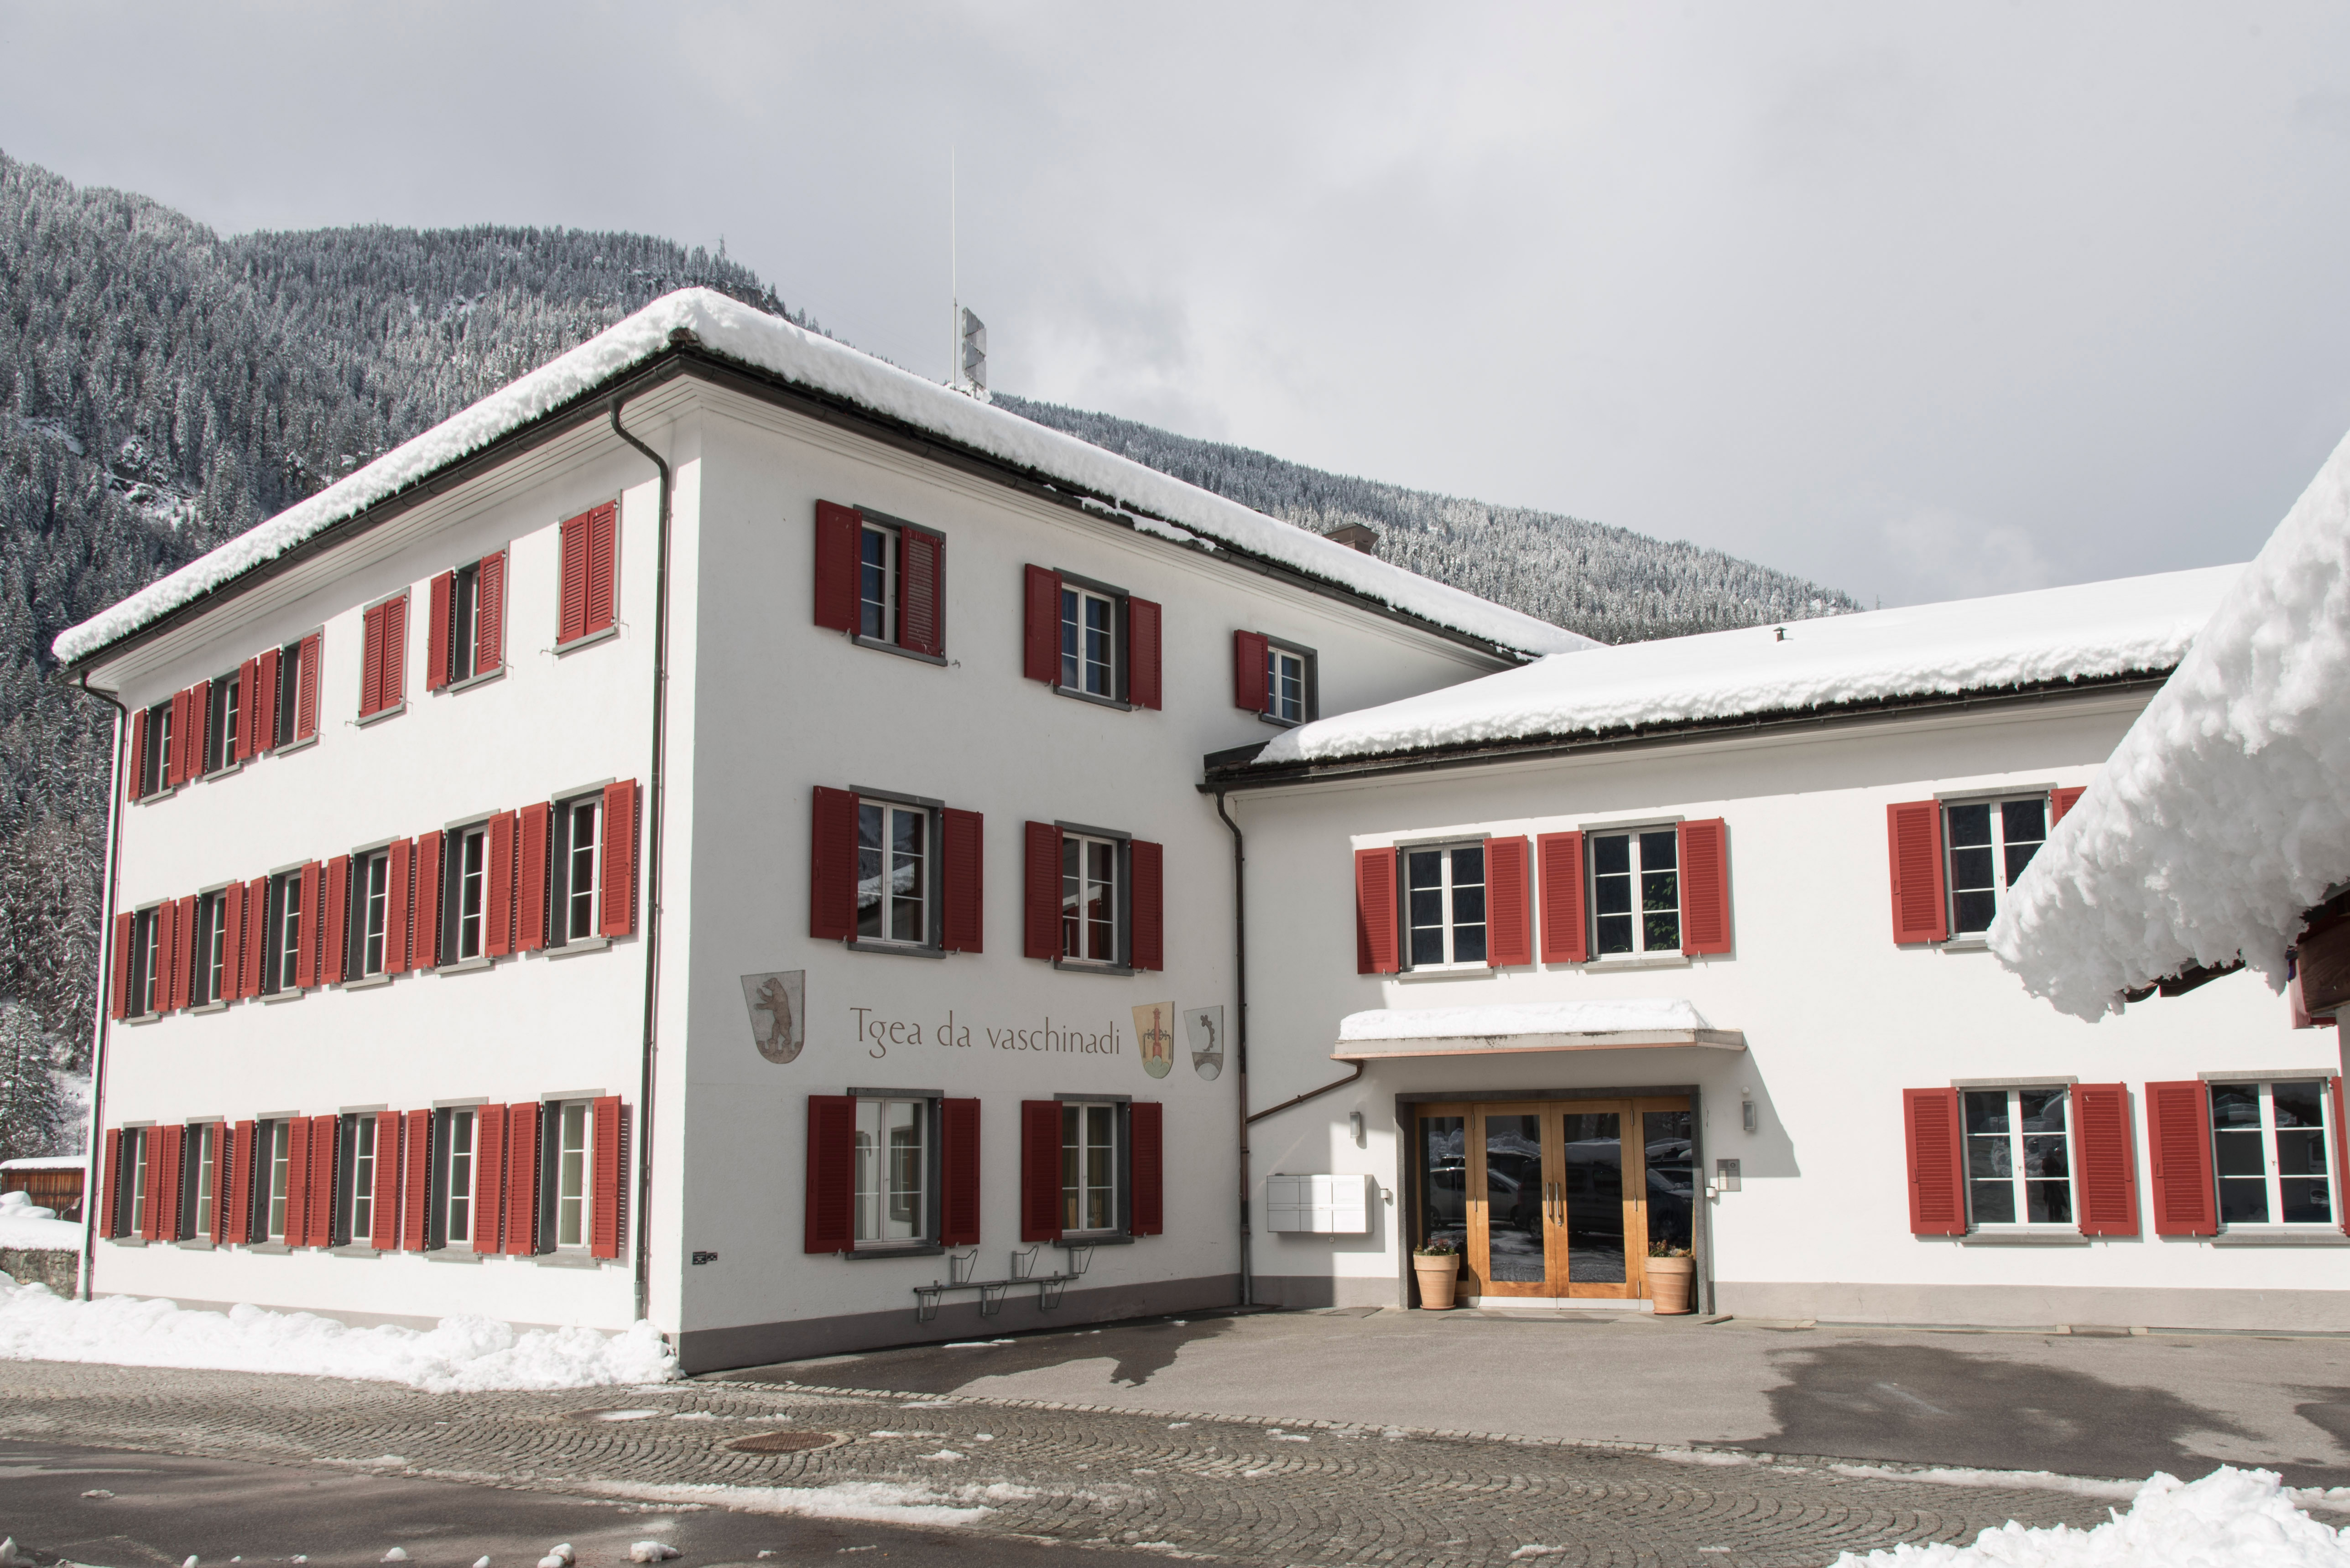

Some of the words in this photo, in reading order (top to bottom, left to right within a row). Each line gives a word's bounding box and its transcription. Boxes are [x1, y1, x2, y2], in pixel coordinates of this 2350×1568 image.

[849, 1007, 922, 1059] Tgea
[937, 1010, 971, 1047] da
[986, 1016, 1119, 1054] vaschinadi
